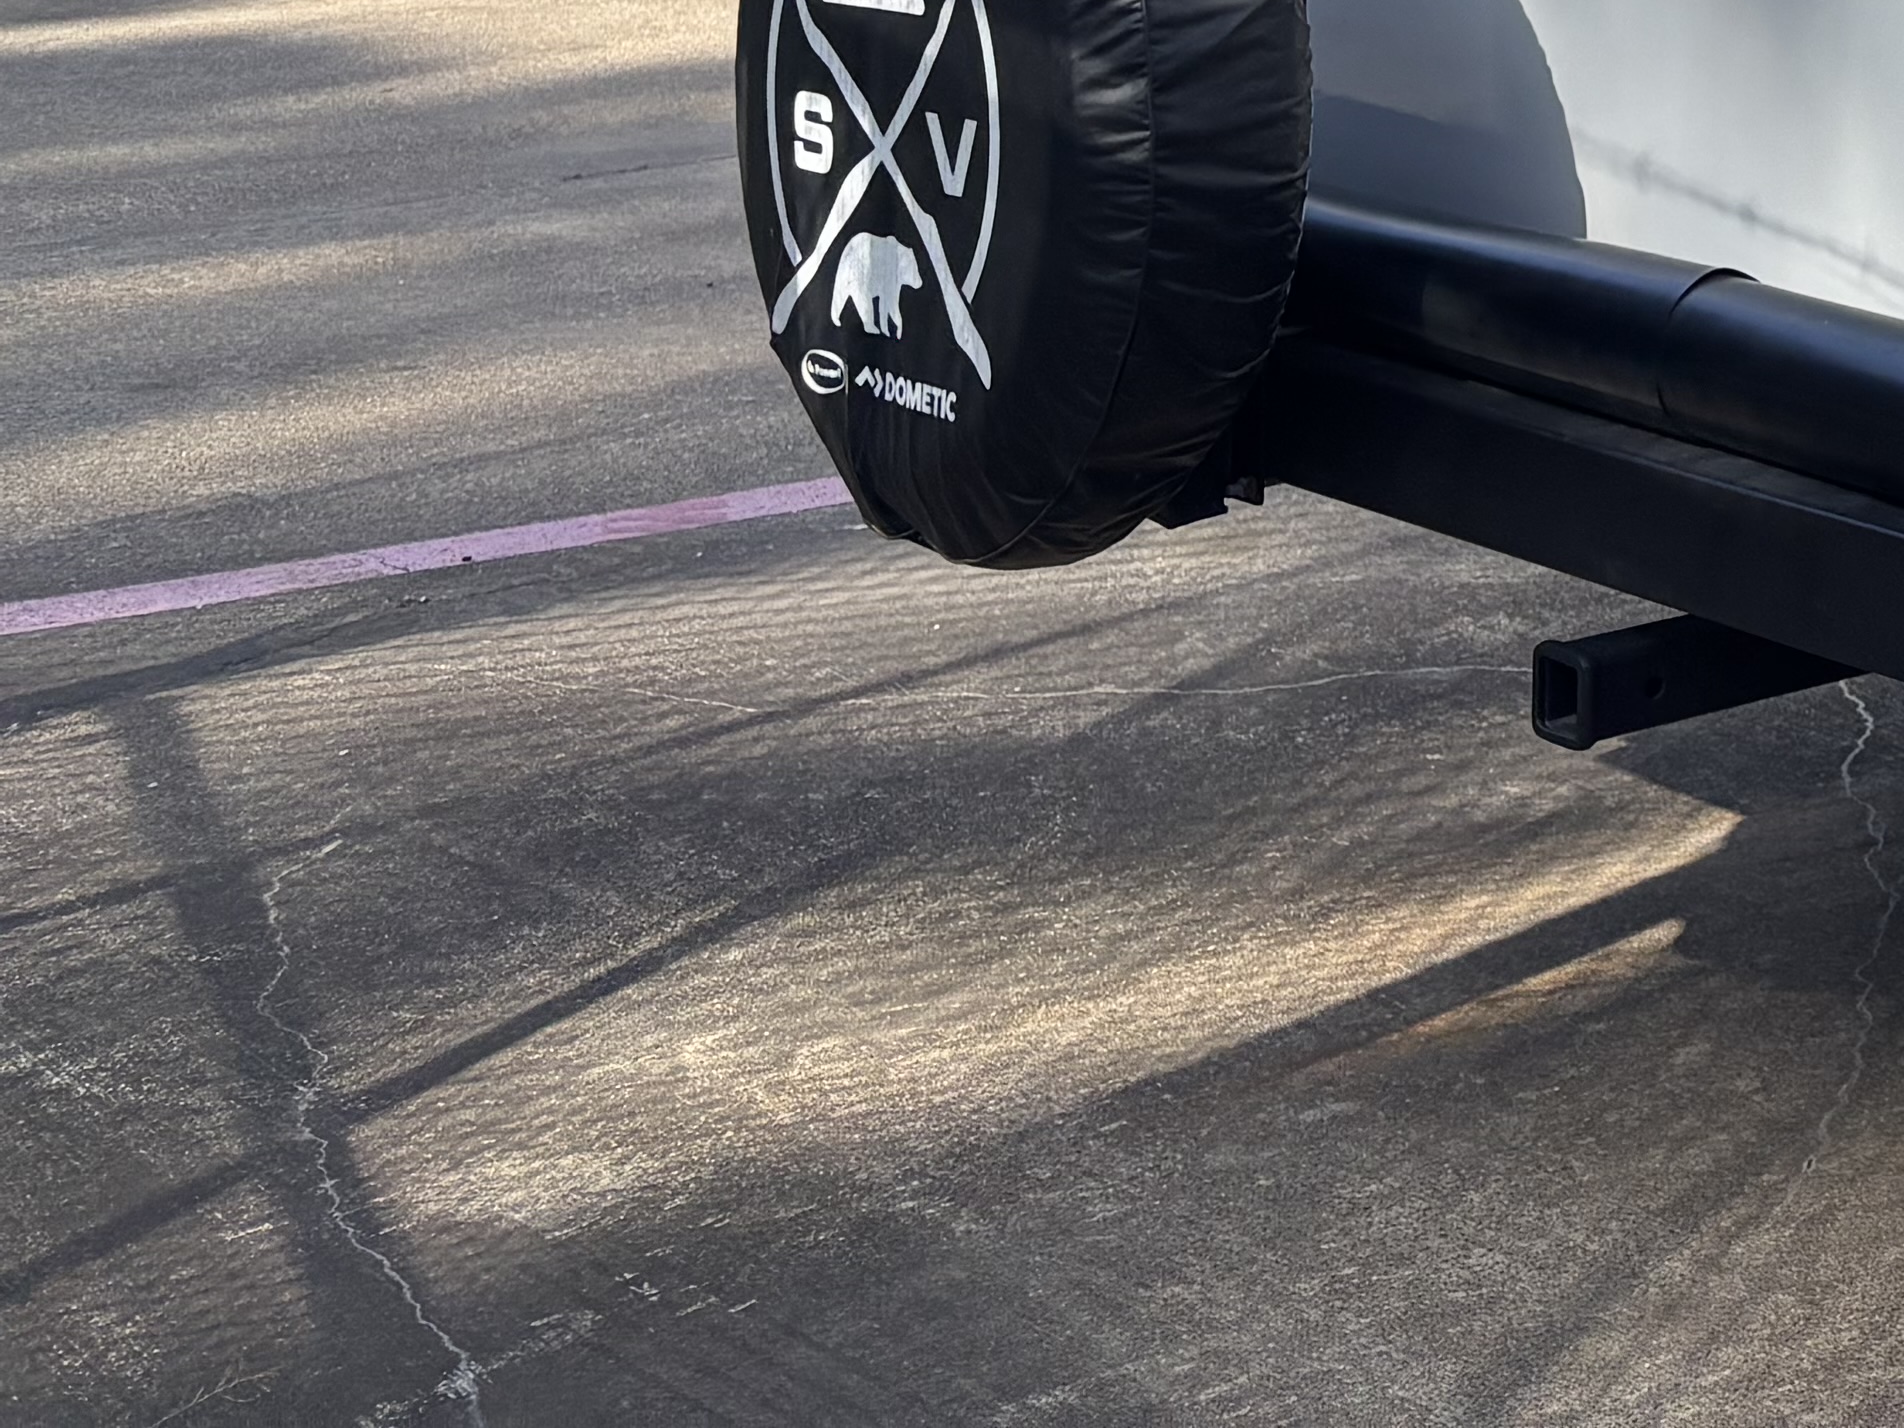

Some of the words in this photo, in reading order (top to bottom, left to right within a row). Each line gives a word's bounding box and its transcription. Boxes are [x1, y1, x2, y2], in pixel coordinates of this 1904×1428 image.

[791, 90, 834, 175] S
[925, 111, 978, 198] V
[884, 371, 957, 423] DOMETIC
